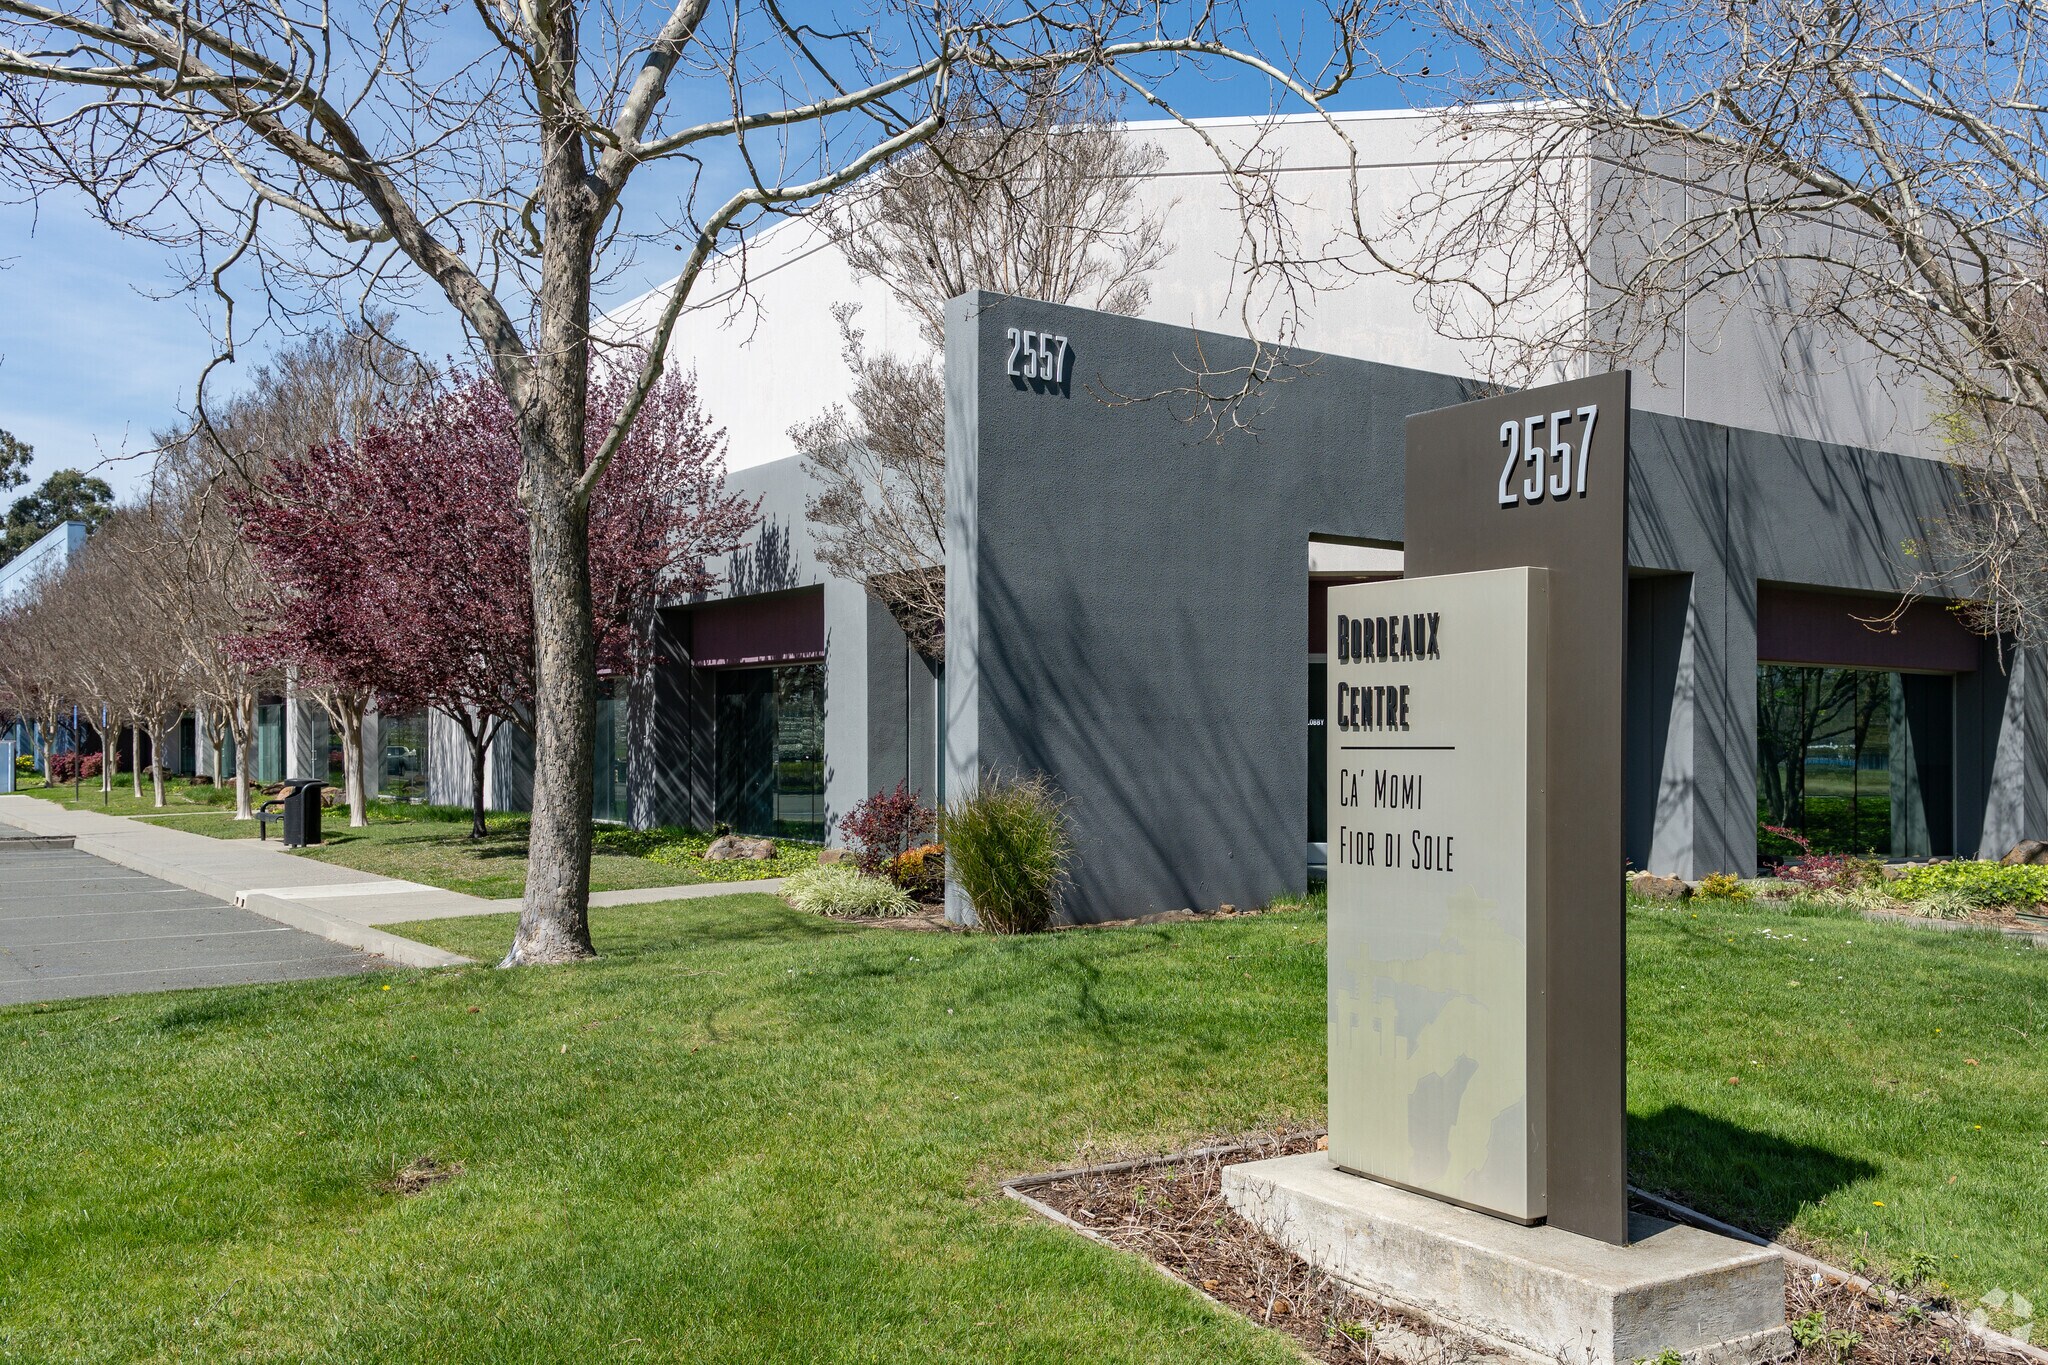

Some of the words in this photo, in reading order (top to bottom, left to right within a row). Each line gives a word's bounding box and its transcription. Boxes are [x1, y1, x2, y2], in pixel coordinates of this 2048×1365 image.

[1007, 328, 1068, 383] 2557
[1498, 404, 1598, 504] 2557
[1337, 612, 1440, 661] BORDEAUX
[1337, 681, 1410, 728] CENTRE
[1340, 769, 1364, 808] CA'
[1374, 769, 1422, 810] MOMI
[1340, 826, 1375, 866] FIOR
[1385, 833, 1401, 868] DI
[1412, 830, 1454, 872] SOLE
